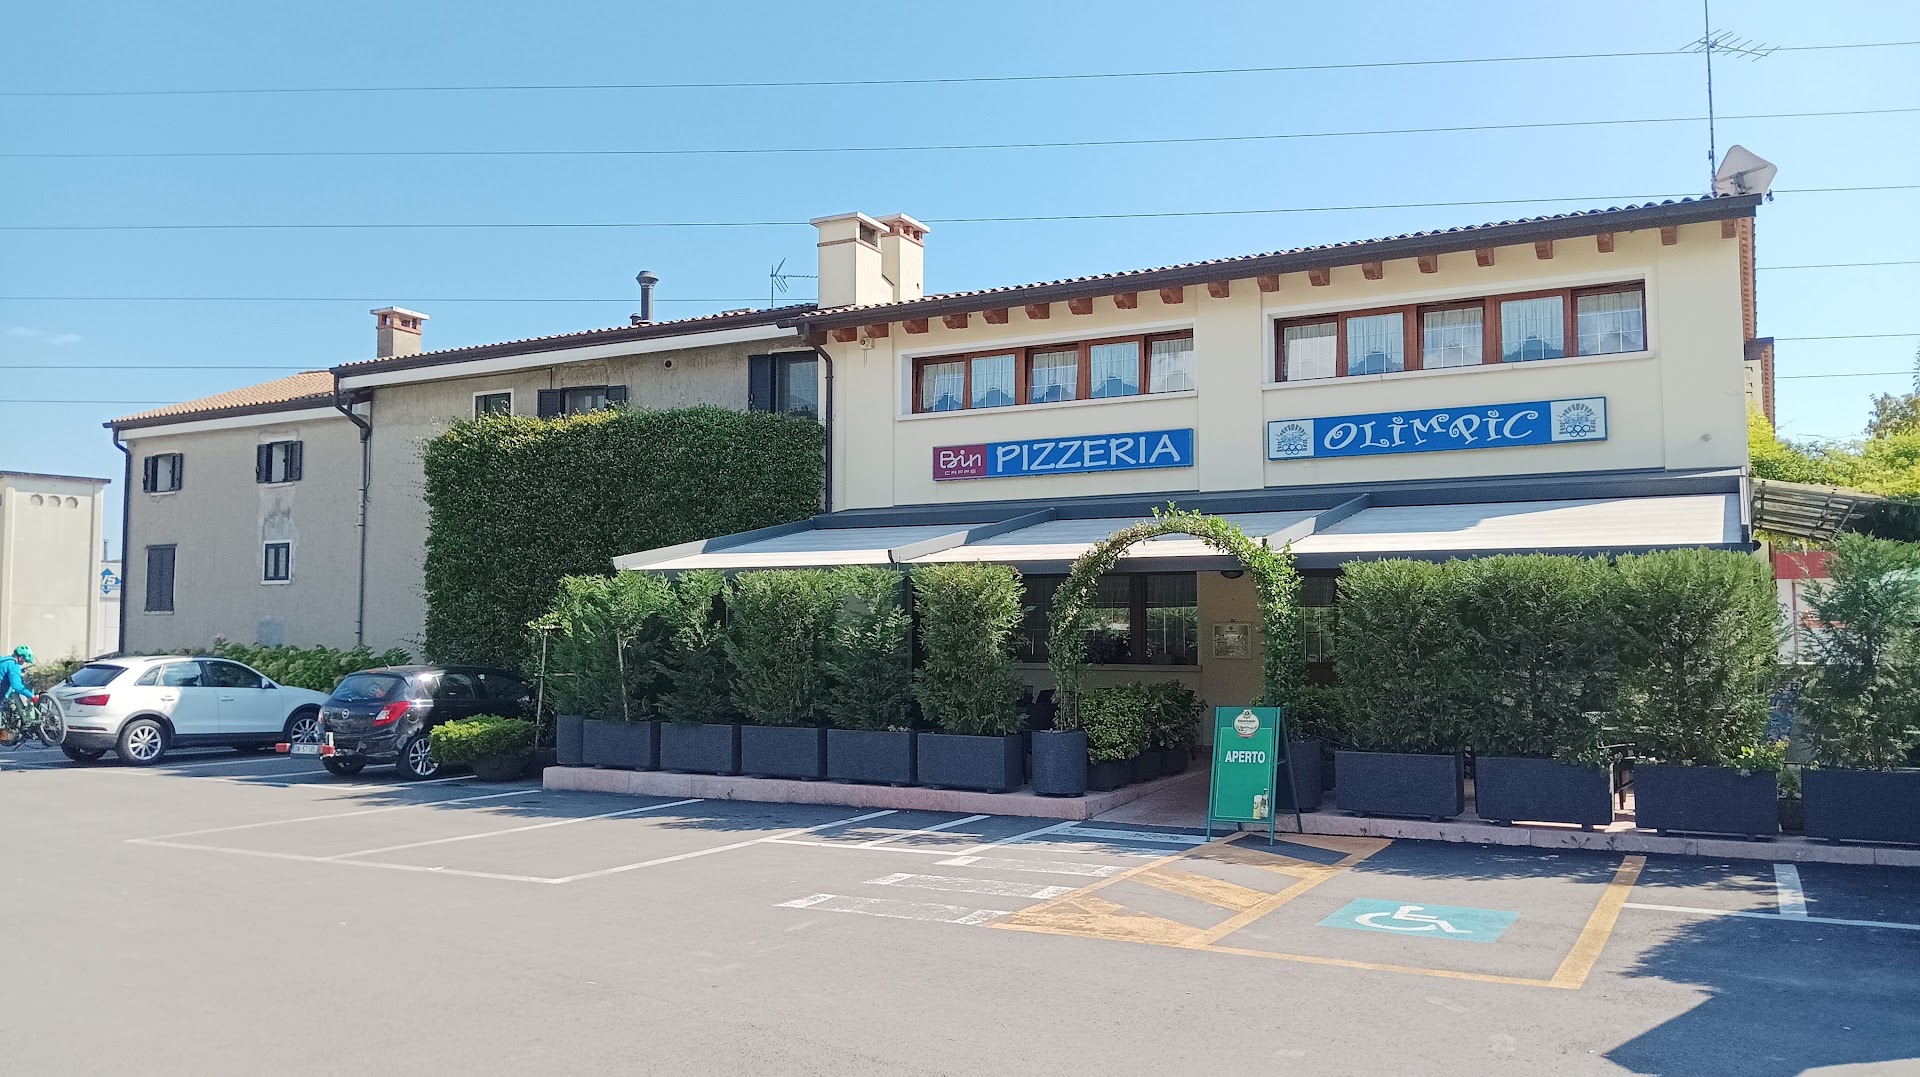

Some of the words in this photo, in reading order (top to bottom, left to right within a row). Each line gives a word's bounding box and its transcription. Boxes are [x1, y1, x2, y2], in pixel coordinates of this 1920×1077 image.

[1323, 409, 1539, 450] OLIMPIC
[940, 449, 982, 469] Bin
[996, 434, 1181, 473] PIZZERIA
[1224, 750, 1266, 764] APERTO
